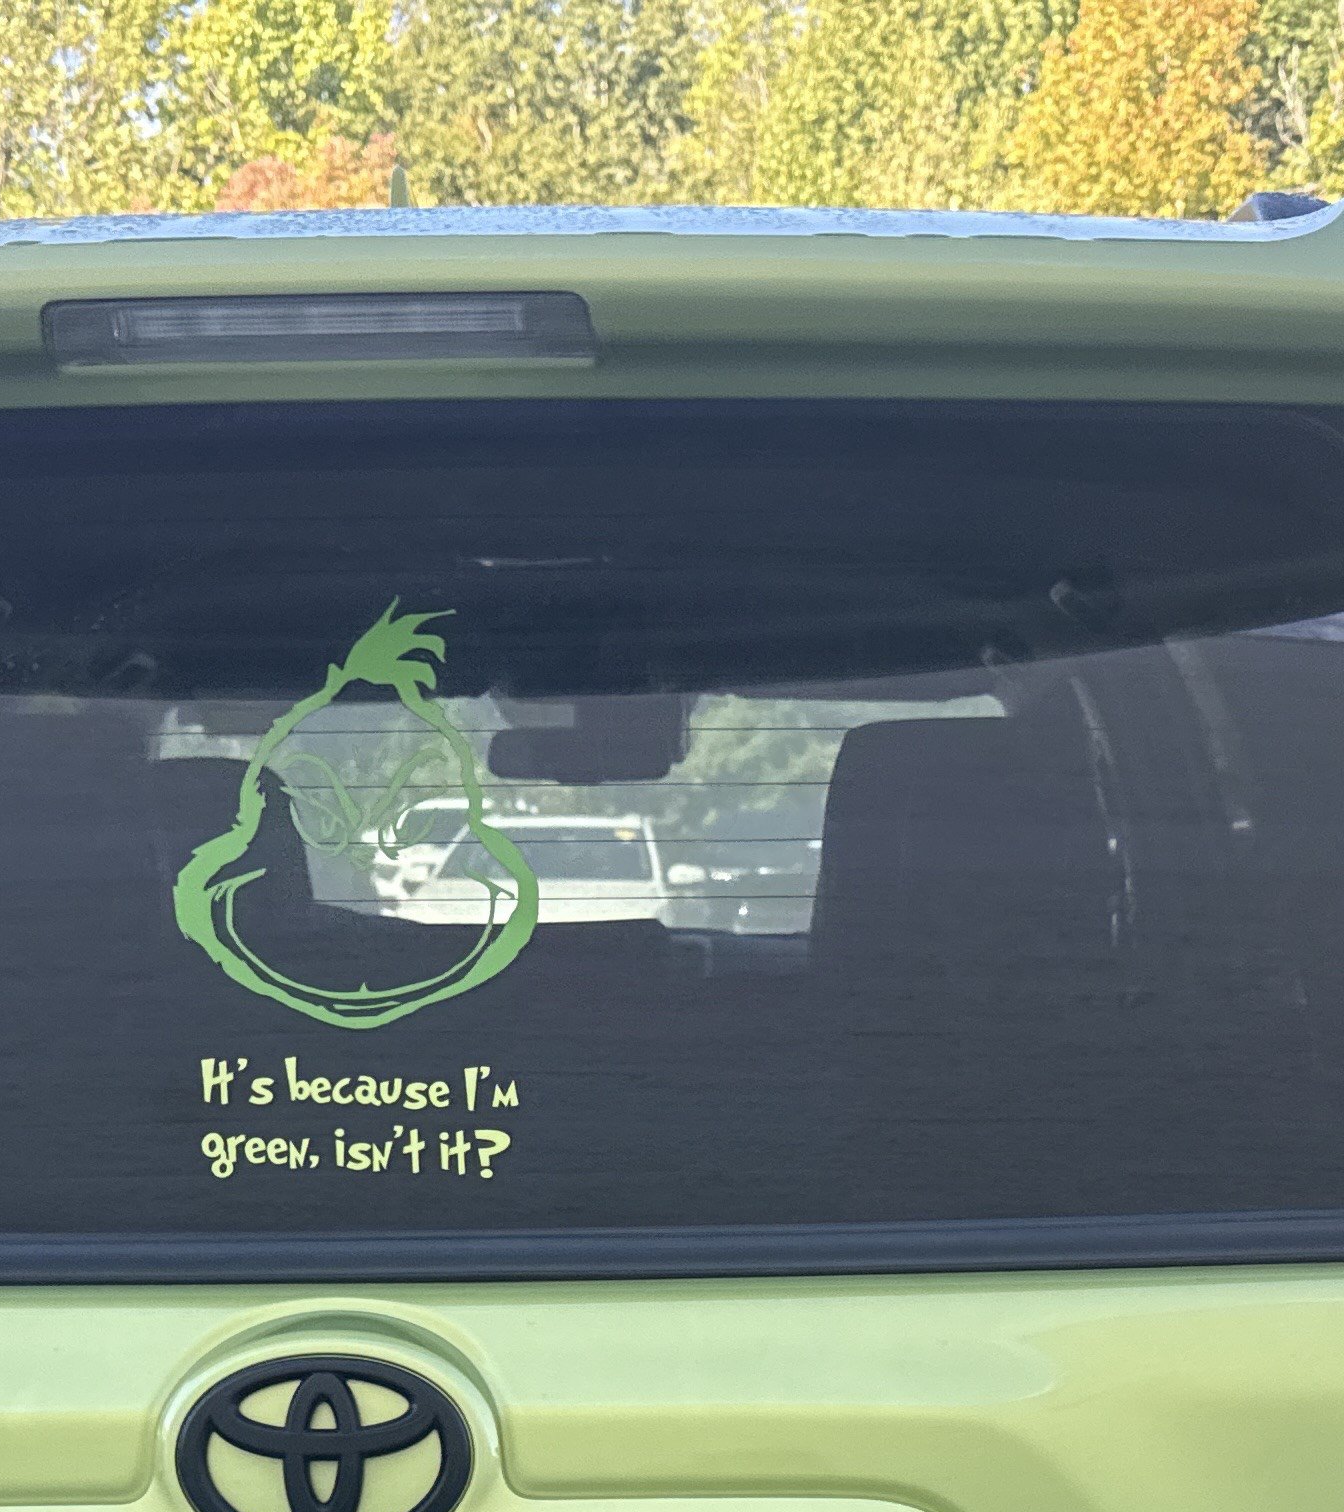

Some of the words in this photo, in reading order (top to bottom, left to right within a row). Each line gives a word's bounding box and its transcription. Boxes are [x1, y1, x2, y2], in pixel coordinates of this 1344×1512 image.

[201, 1057, 275, 1105] It's
[284, 1056, 450, 1110] because
[201, 1132, 320, 1179] green,
[334, 1124, 426, 1174] isn't
[438, 1129, 511, 1179] it?
